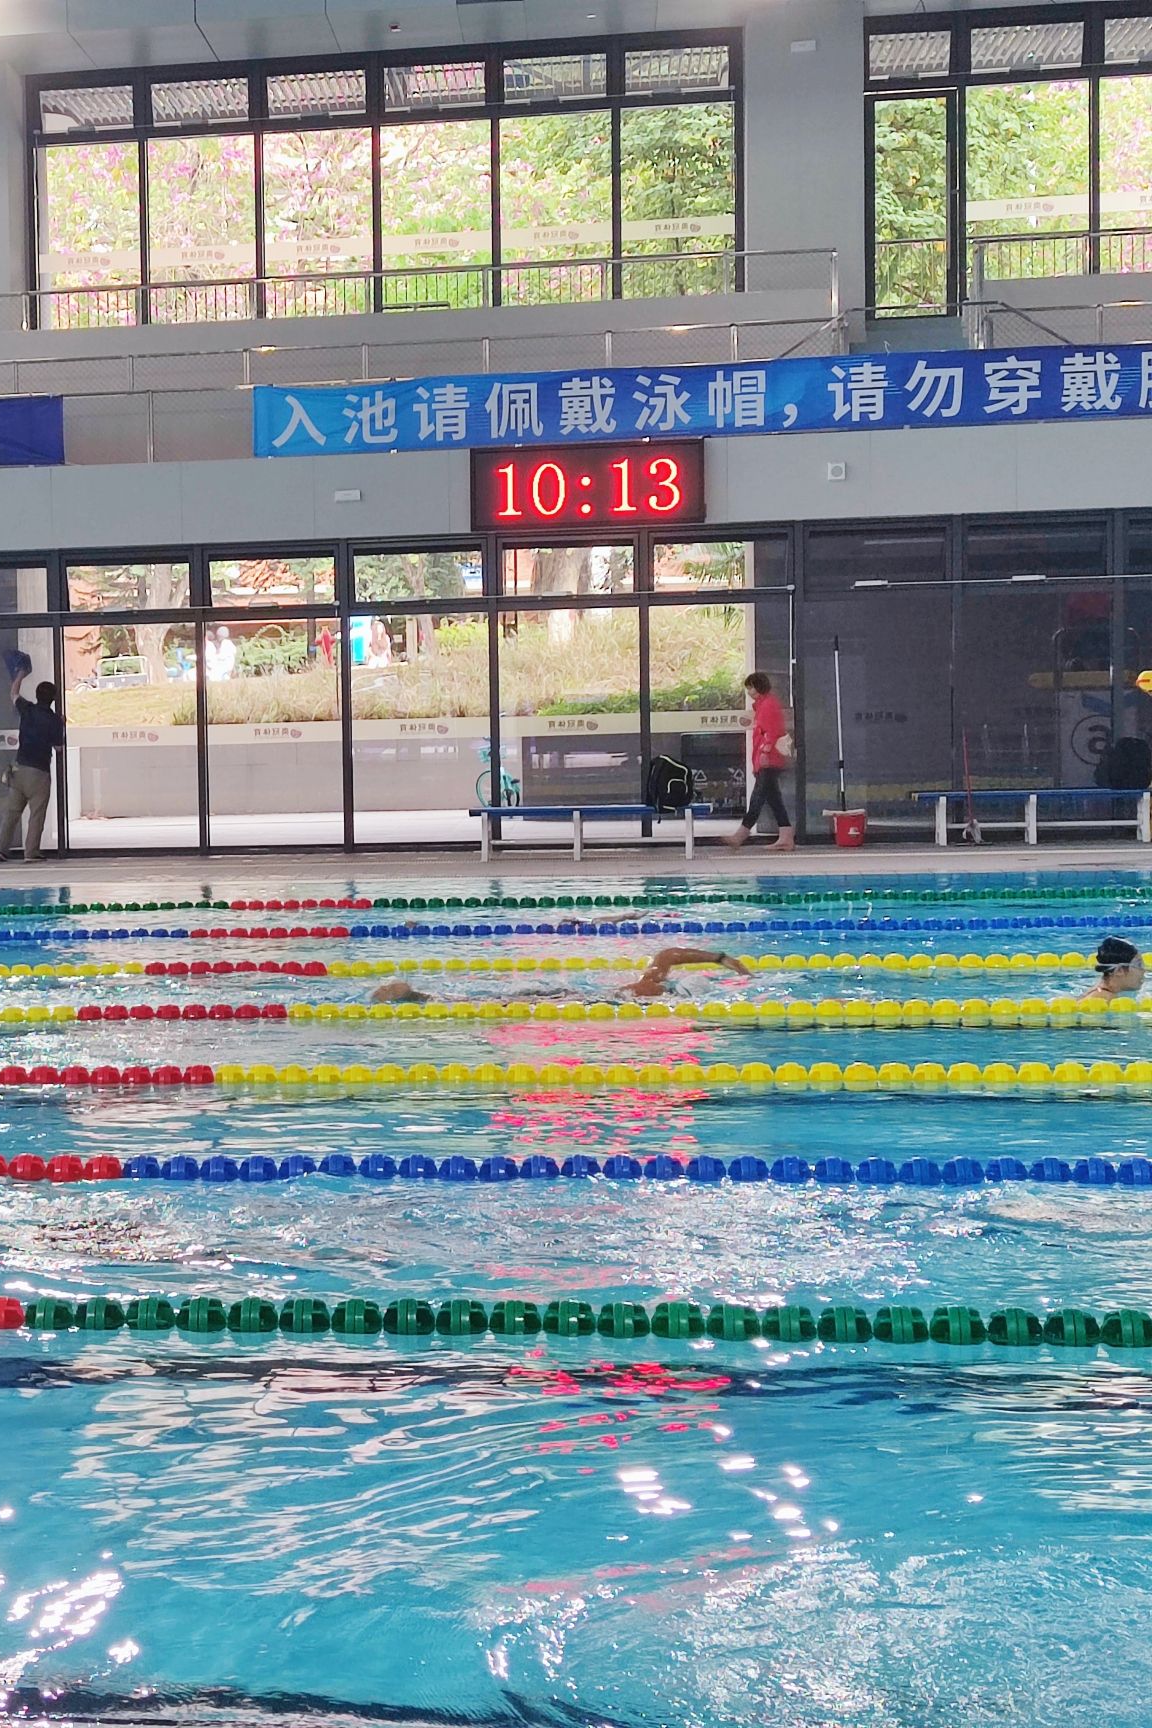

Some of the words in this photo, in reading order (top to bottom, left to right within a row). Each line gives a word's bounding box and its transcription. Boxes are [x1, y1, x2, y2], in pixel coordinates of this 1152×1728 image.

[272, 351, 1152, 448] 入池请佩戴泳帽，请勿穿戴
[498, 457, 681, 516] 10:13
